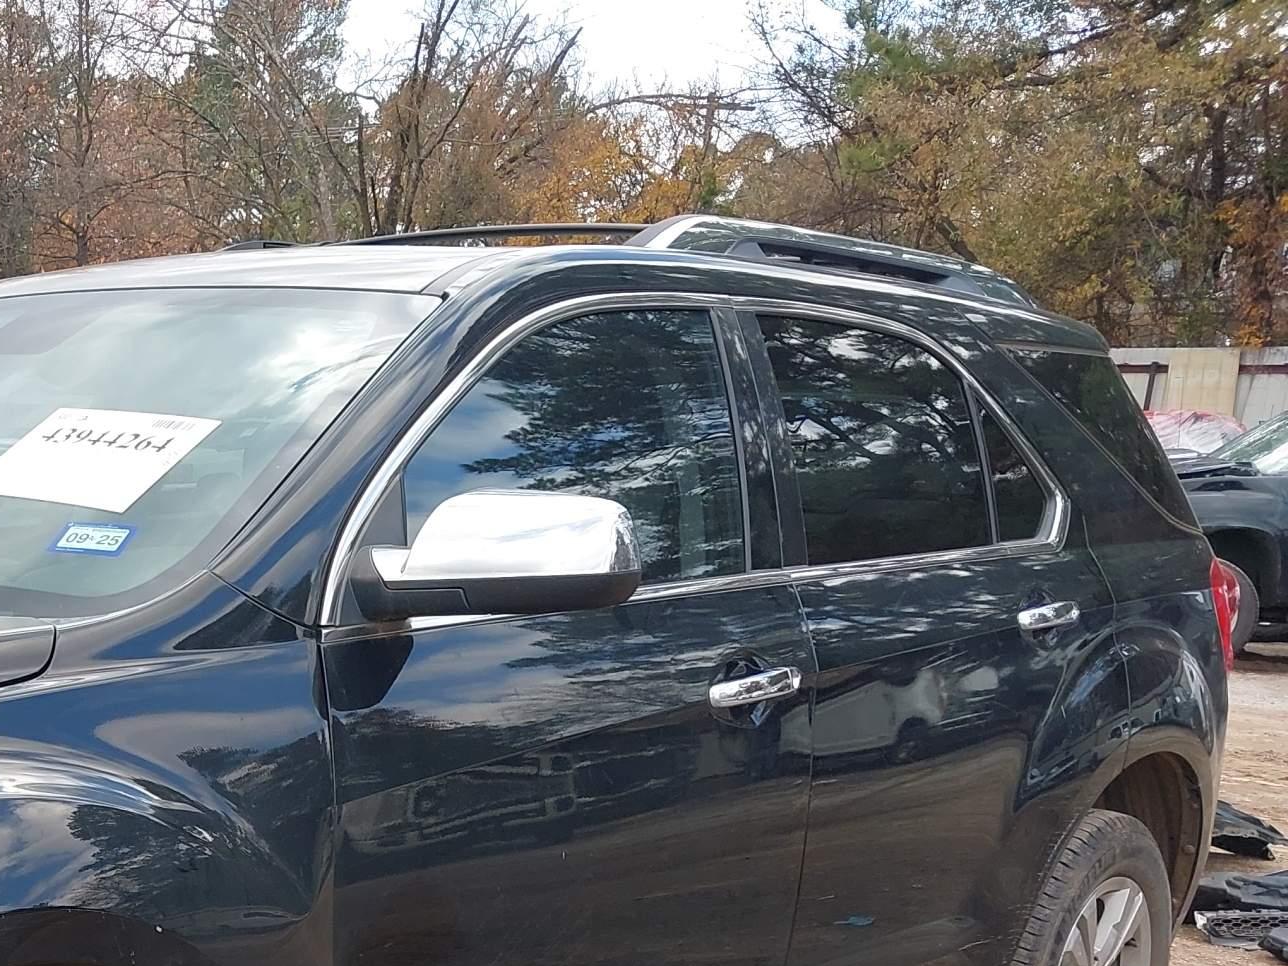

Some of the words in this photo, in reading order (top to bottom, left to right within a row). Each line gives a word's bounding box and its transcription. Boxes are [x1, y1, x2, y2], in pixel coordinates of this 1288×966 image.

[41, 426, 176, 453] 43944264
[65, 532, 90, 544] 09
[96, 534, 123, 546] 25
